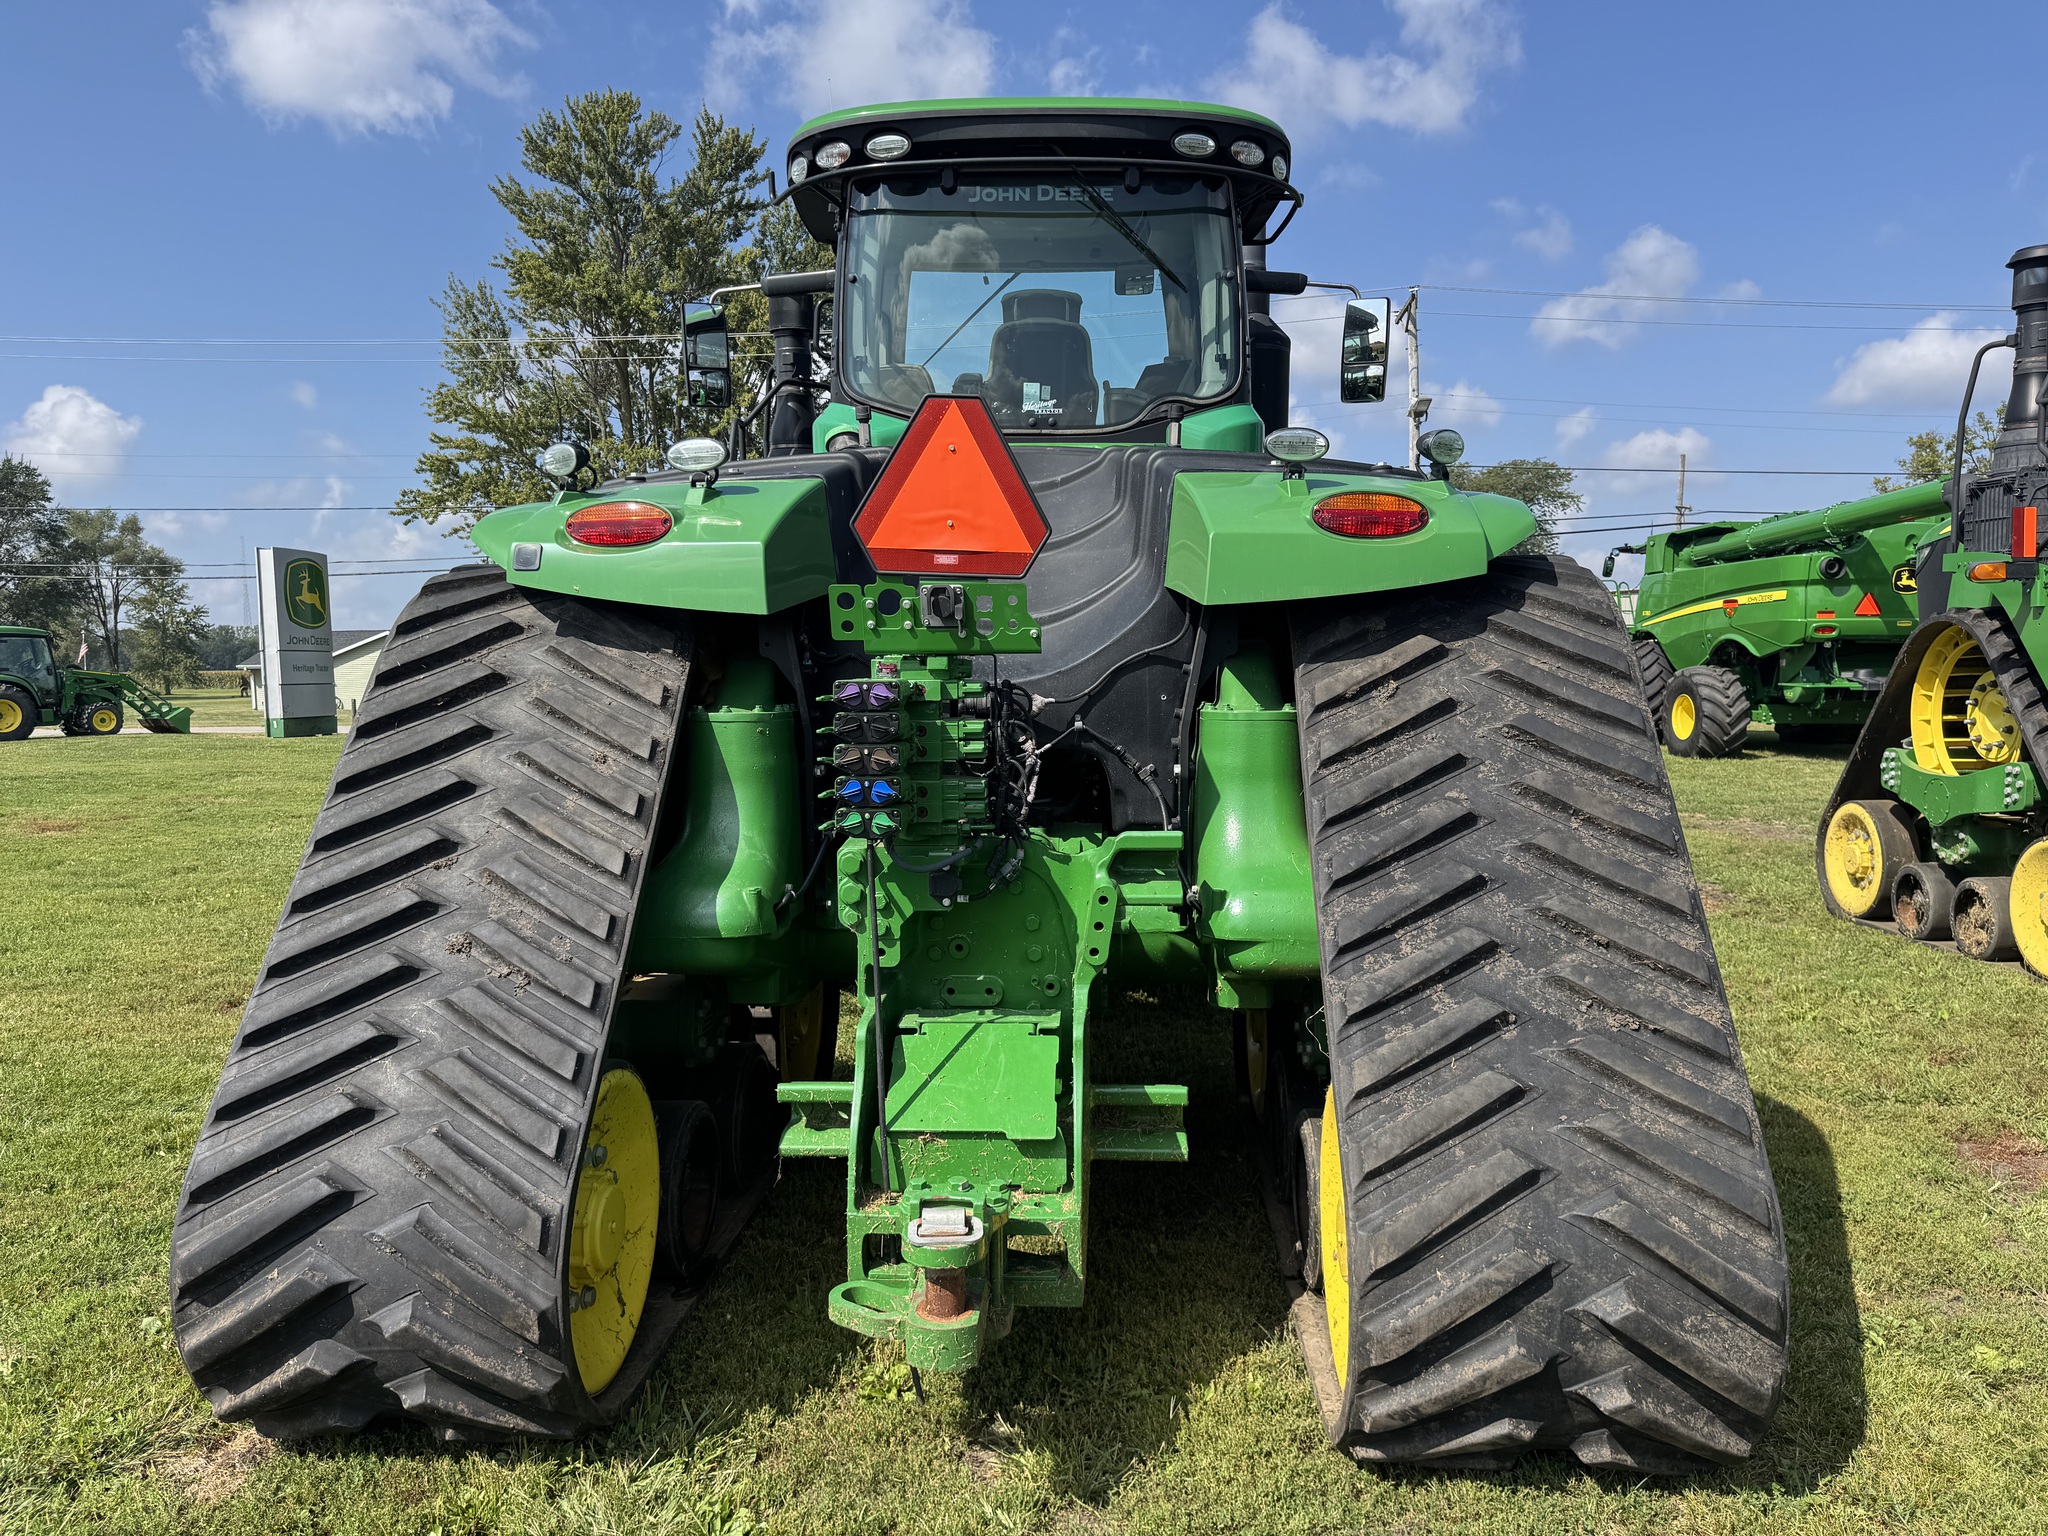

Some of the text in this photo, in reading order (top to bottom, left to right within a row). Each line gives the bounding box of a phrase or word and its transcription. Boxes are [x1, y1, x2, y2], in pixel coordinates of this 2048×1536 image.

[968, 185, 1030, 202] JOHN
[1021, 399, 1057, 413] Heritage
[286, 634, 330, 646] JOHN DEERE
[292, 664, 329, 674] Heritage Tractor
